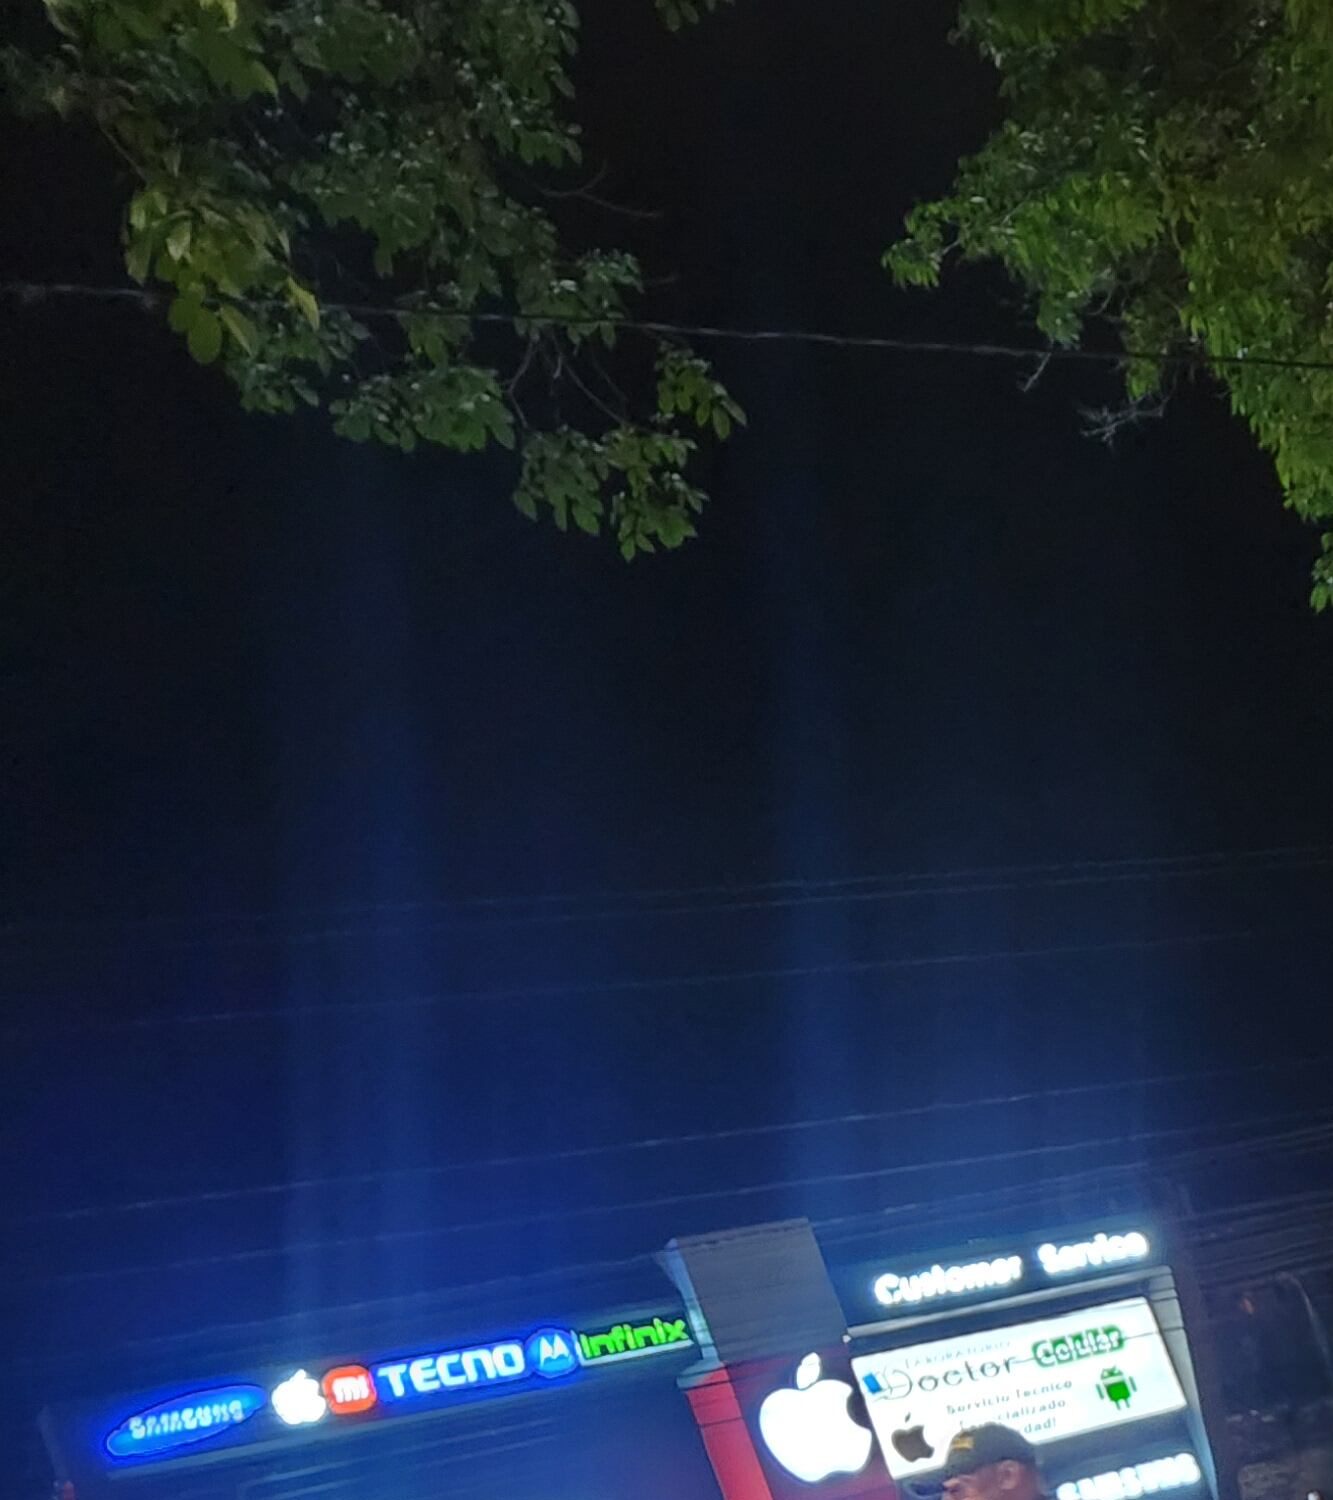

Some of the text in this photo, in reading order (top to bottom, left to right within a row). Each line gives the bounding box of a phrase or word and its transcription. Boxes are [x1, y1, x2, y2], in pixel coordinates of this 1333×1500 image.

[873, 1231, 1148, 1305] Customer Service
[377, 1342, 527, 1398] TECNO
[876, 1355, 1017, 1401] Doctor
[129, 1400, 245, 1440] SAMSUNG
